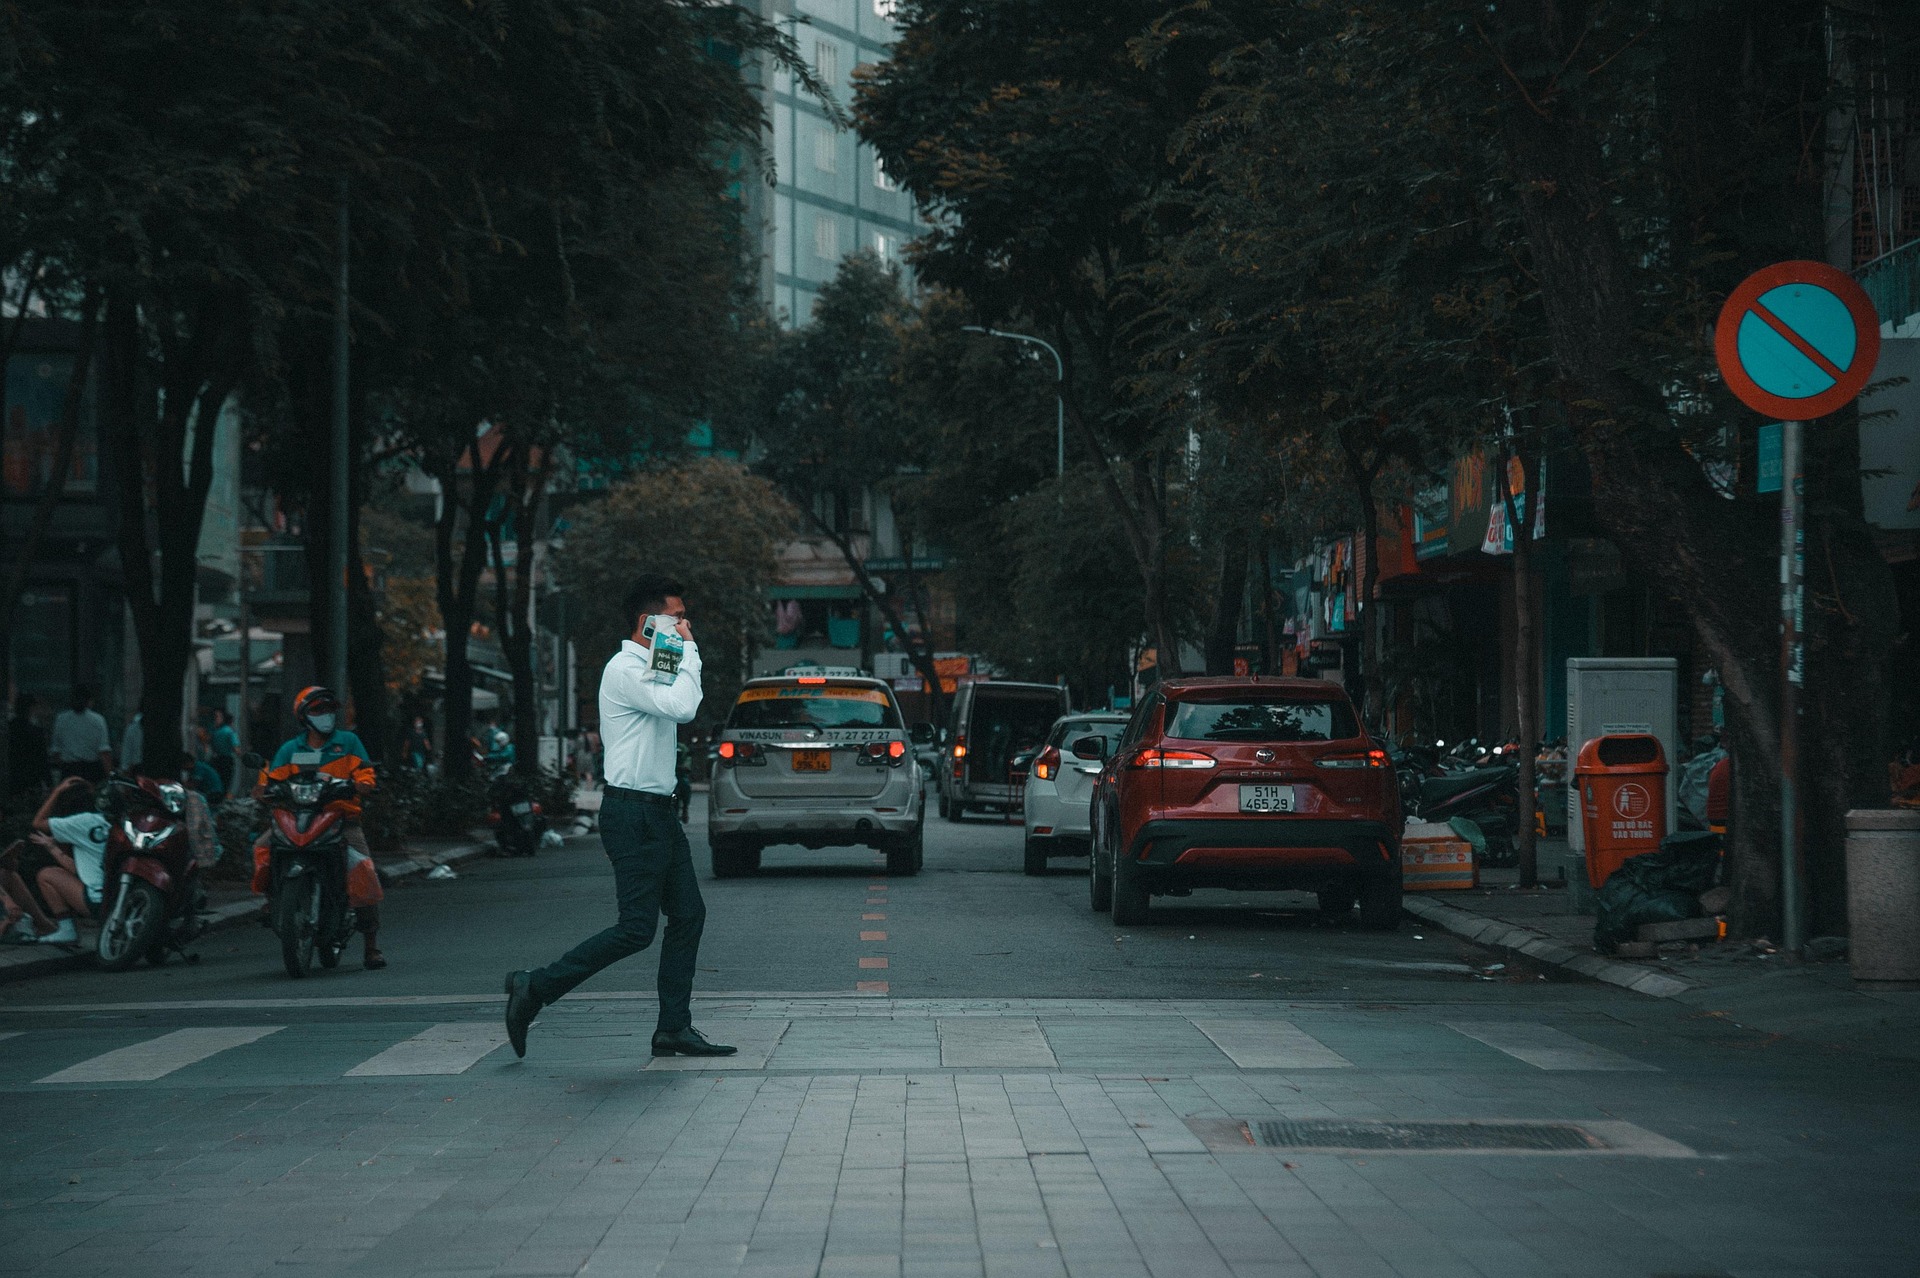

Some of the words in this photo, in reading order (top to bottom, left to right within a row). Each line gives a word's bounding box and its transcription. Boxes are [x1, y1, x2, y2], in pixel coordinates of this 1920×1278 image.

[739, 731, 781, 740] VINASUN
[1255, 787, 1278, 797] 51H
[1246, 798, 1288, 809] 465.29
